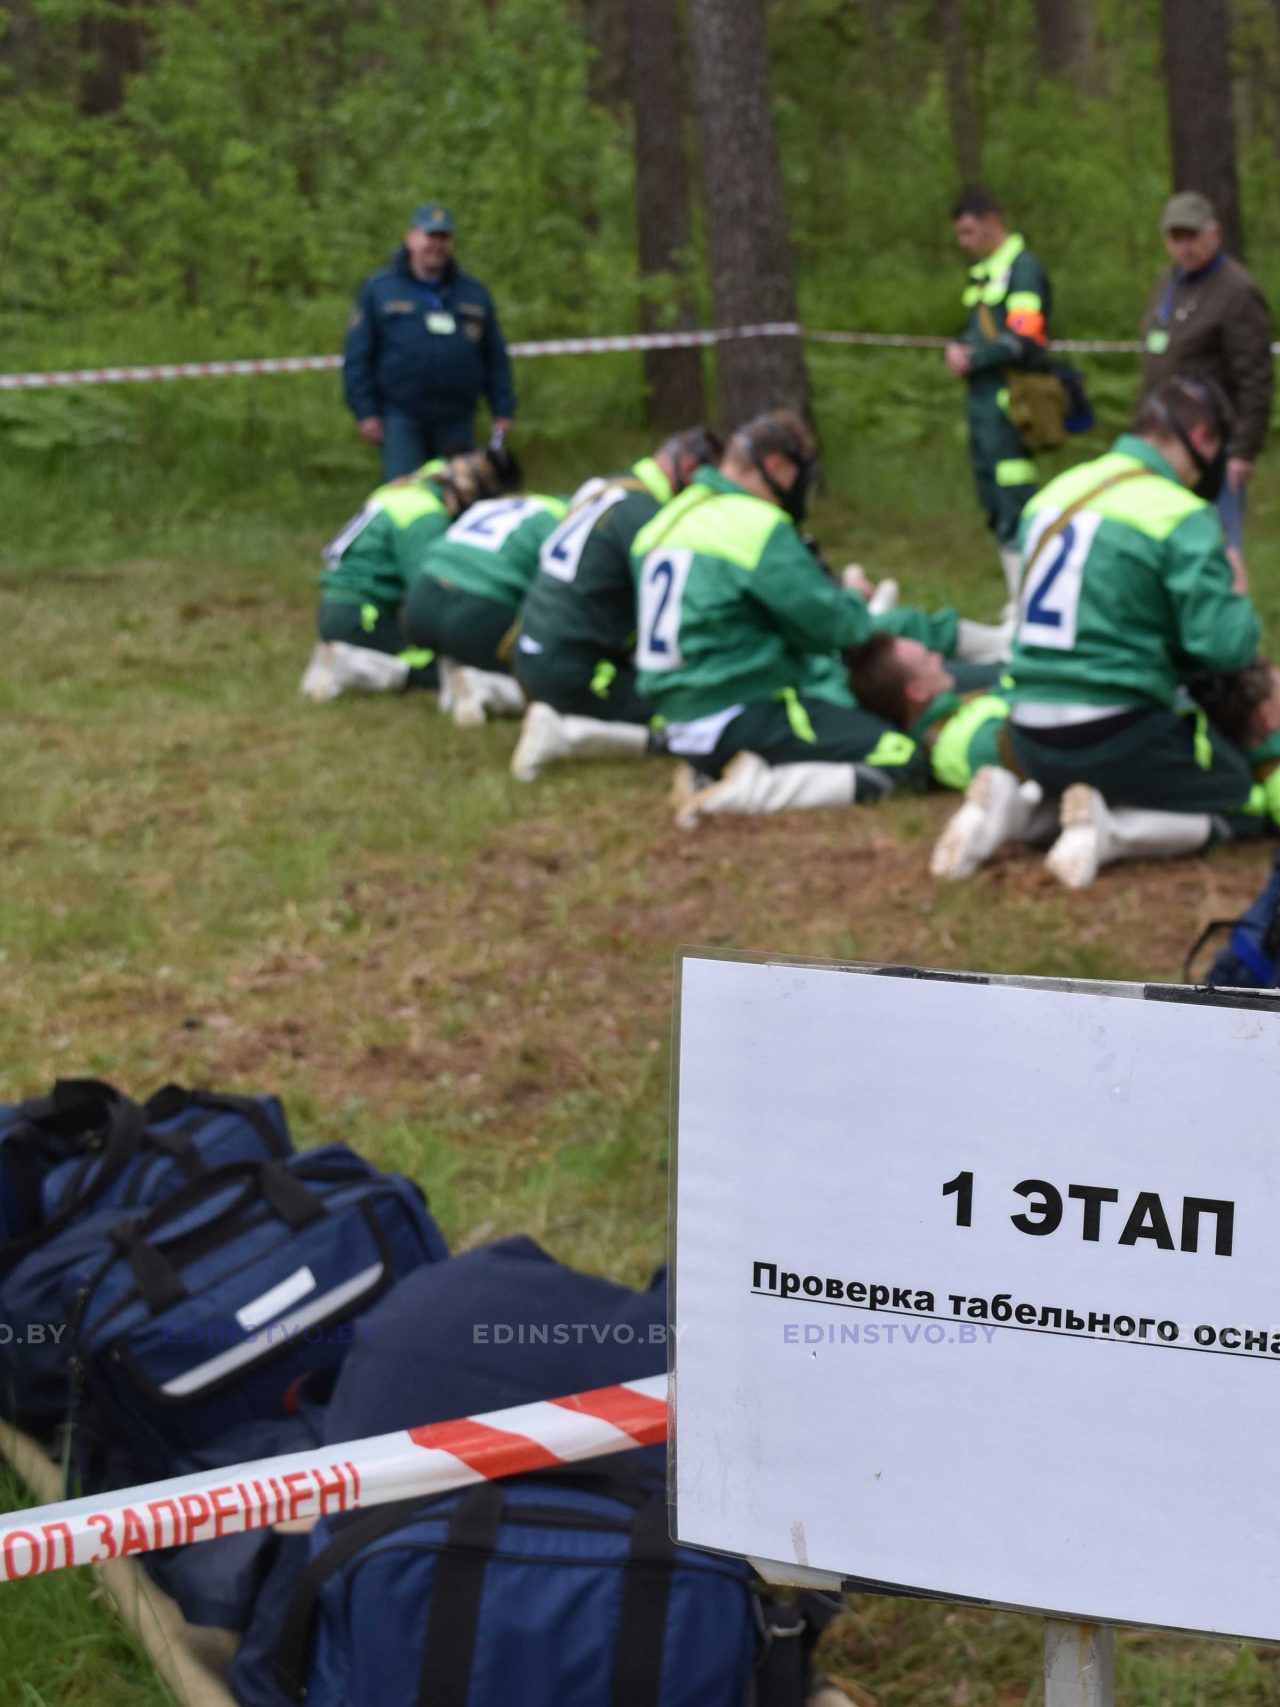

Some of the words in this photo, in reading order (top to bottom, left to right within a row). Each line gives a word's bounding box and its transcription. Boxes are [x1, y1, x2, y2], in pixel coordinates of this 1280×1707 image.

[649, 559, 675, 653] 2
[1026, 521, 1075, 627] 2
[943, 1172, 974, 1228] 1
[1011, 1180, 1235, 1257] ЭТАП
[752, 1262, 935, 1313] Проверка
[948, 1294, 1180, 1342] табельного
